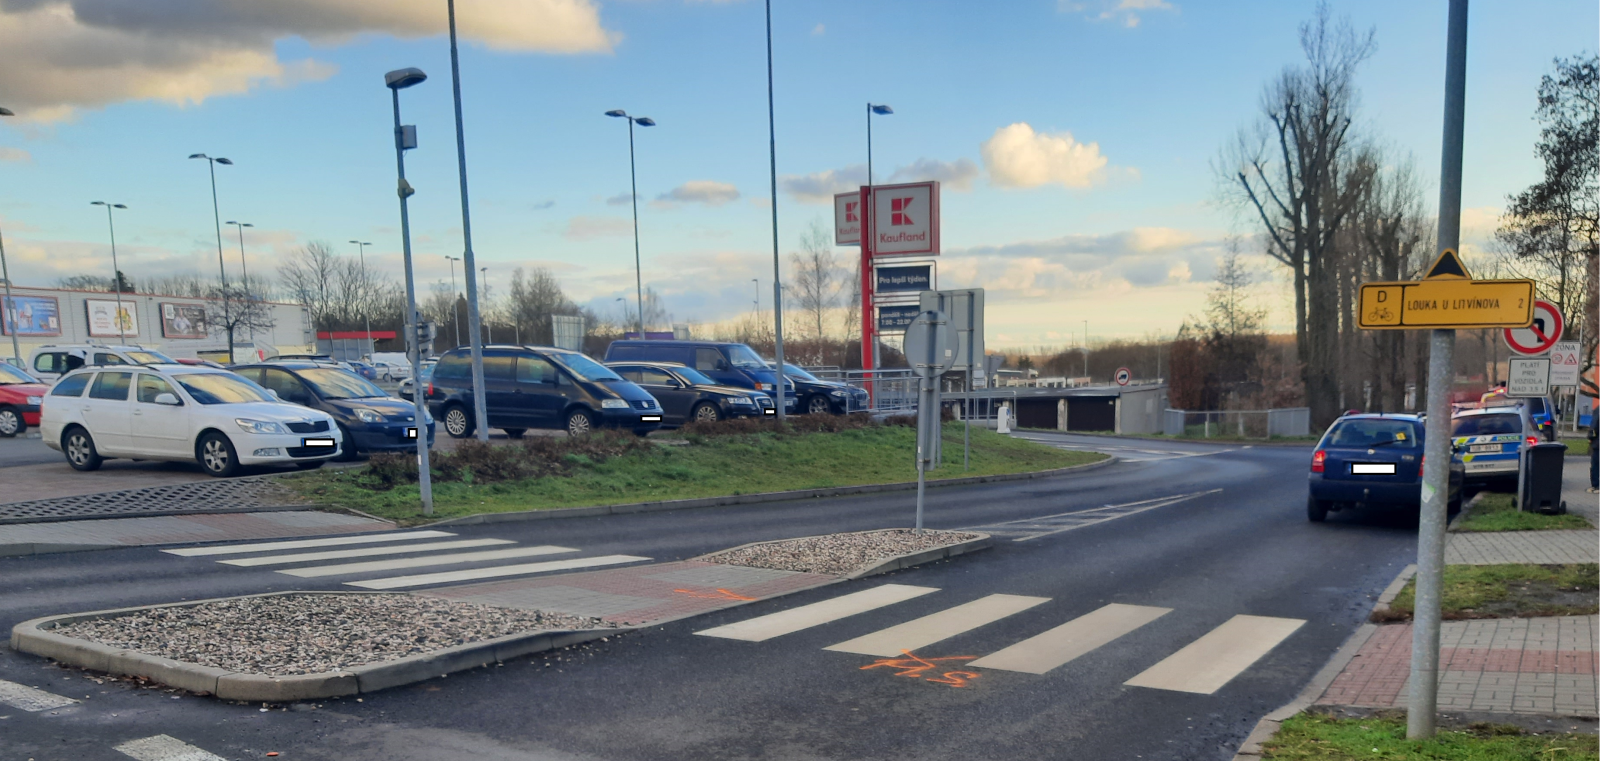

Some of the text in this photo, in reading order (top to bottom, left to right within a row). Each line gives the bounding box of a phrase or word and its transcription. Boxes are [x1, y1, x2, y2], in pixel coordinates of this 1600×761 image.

[846, 202, 858, 222] K
[891, 198, 914, 226] K
[839, 227, 860, 235] Kauflan
[880, 232, 926, 243] Kaufland
[892, 276, 906, 284] lepší
[908, 275, 927, 284] týden.
[1378, 291, 1387, 303] D
[1408, 297, 1523, 310] LOUKA U LITVÍNOVA 2
